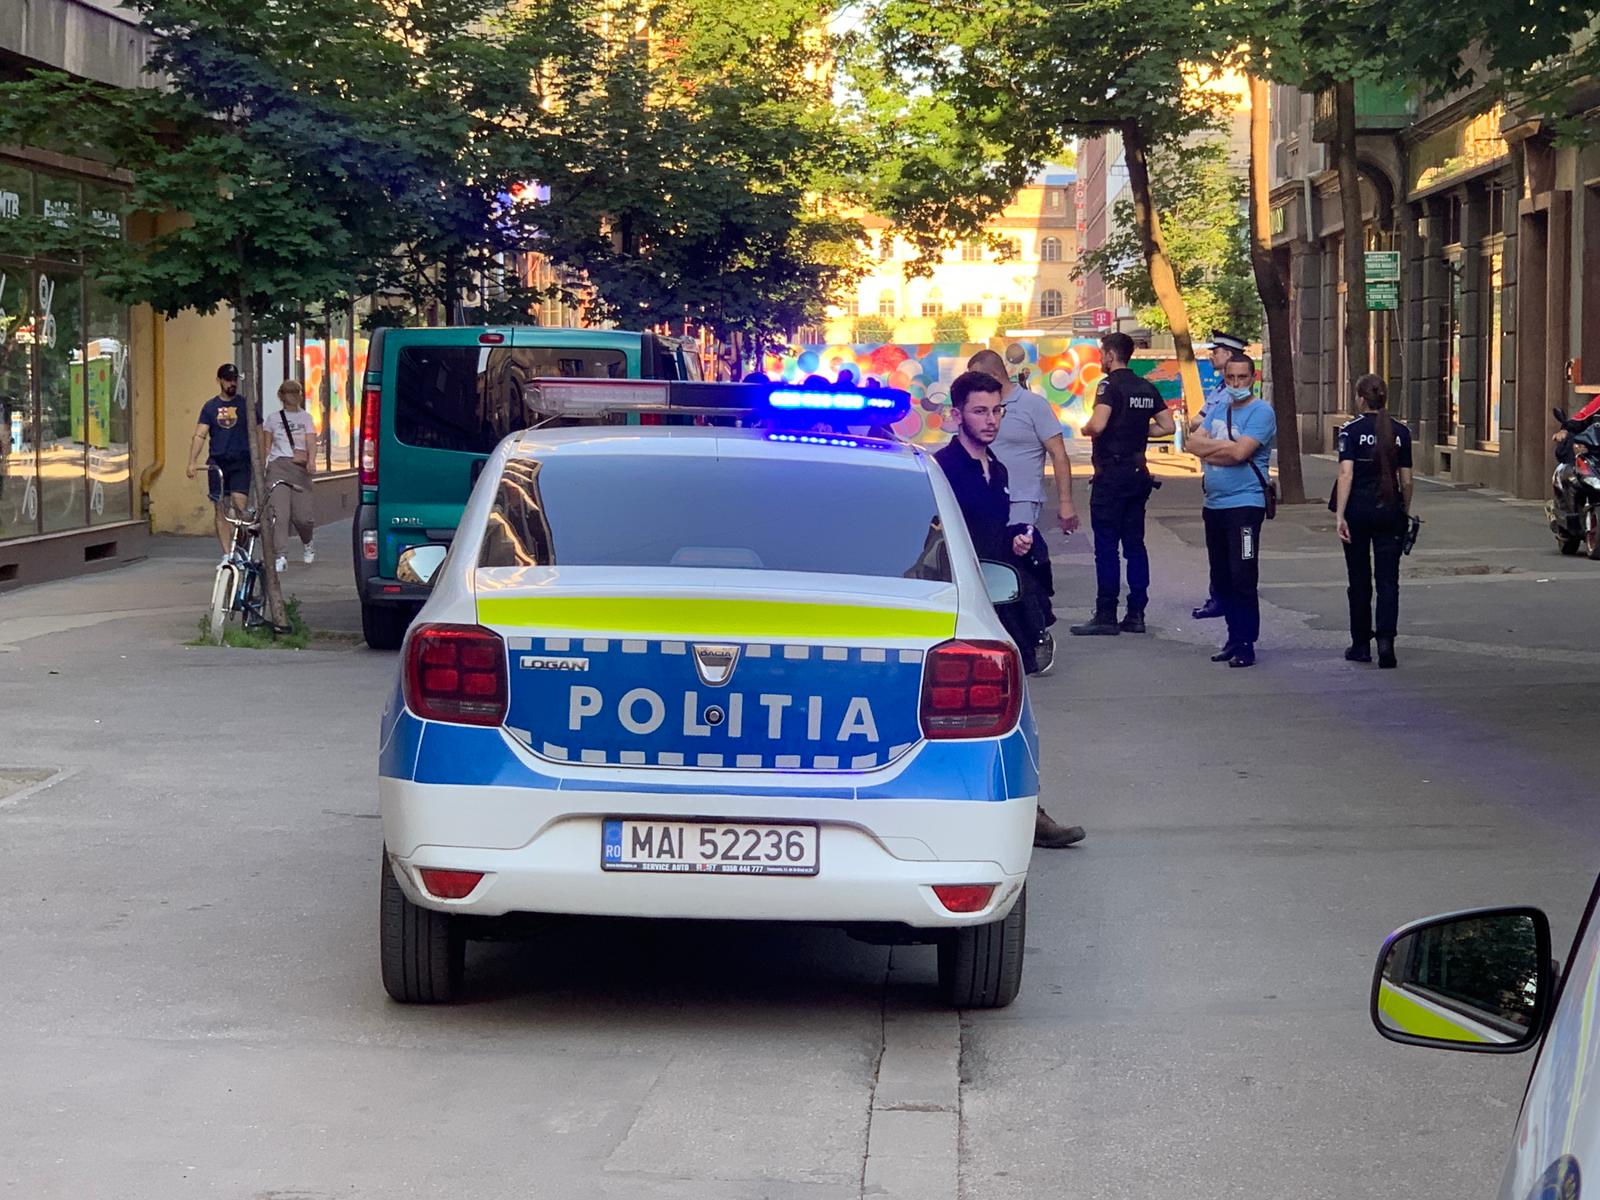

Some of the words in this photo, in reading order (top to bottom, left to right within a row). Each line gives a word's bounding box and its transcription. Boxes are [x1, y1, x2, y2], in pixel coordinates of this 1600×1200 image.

[1129, 396, 1154, 409] POLITIA
[391, 517, 424, 526] OPEL
[700, 648, 732, 658] DACIA
[520, 656, 589, 672] LOGAN
[569, 685, 880, 743] POLITIA
[632, 826, 684, 859] MAI
[699, 827, 805, 862] 52236
[606, 844, 621, 859] RO
[642, 862, 670, 872] SERVICE
[671, 863, 690, 873] AUTO
[751, 865, 764, 873] 777
